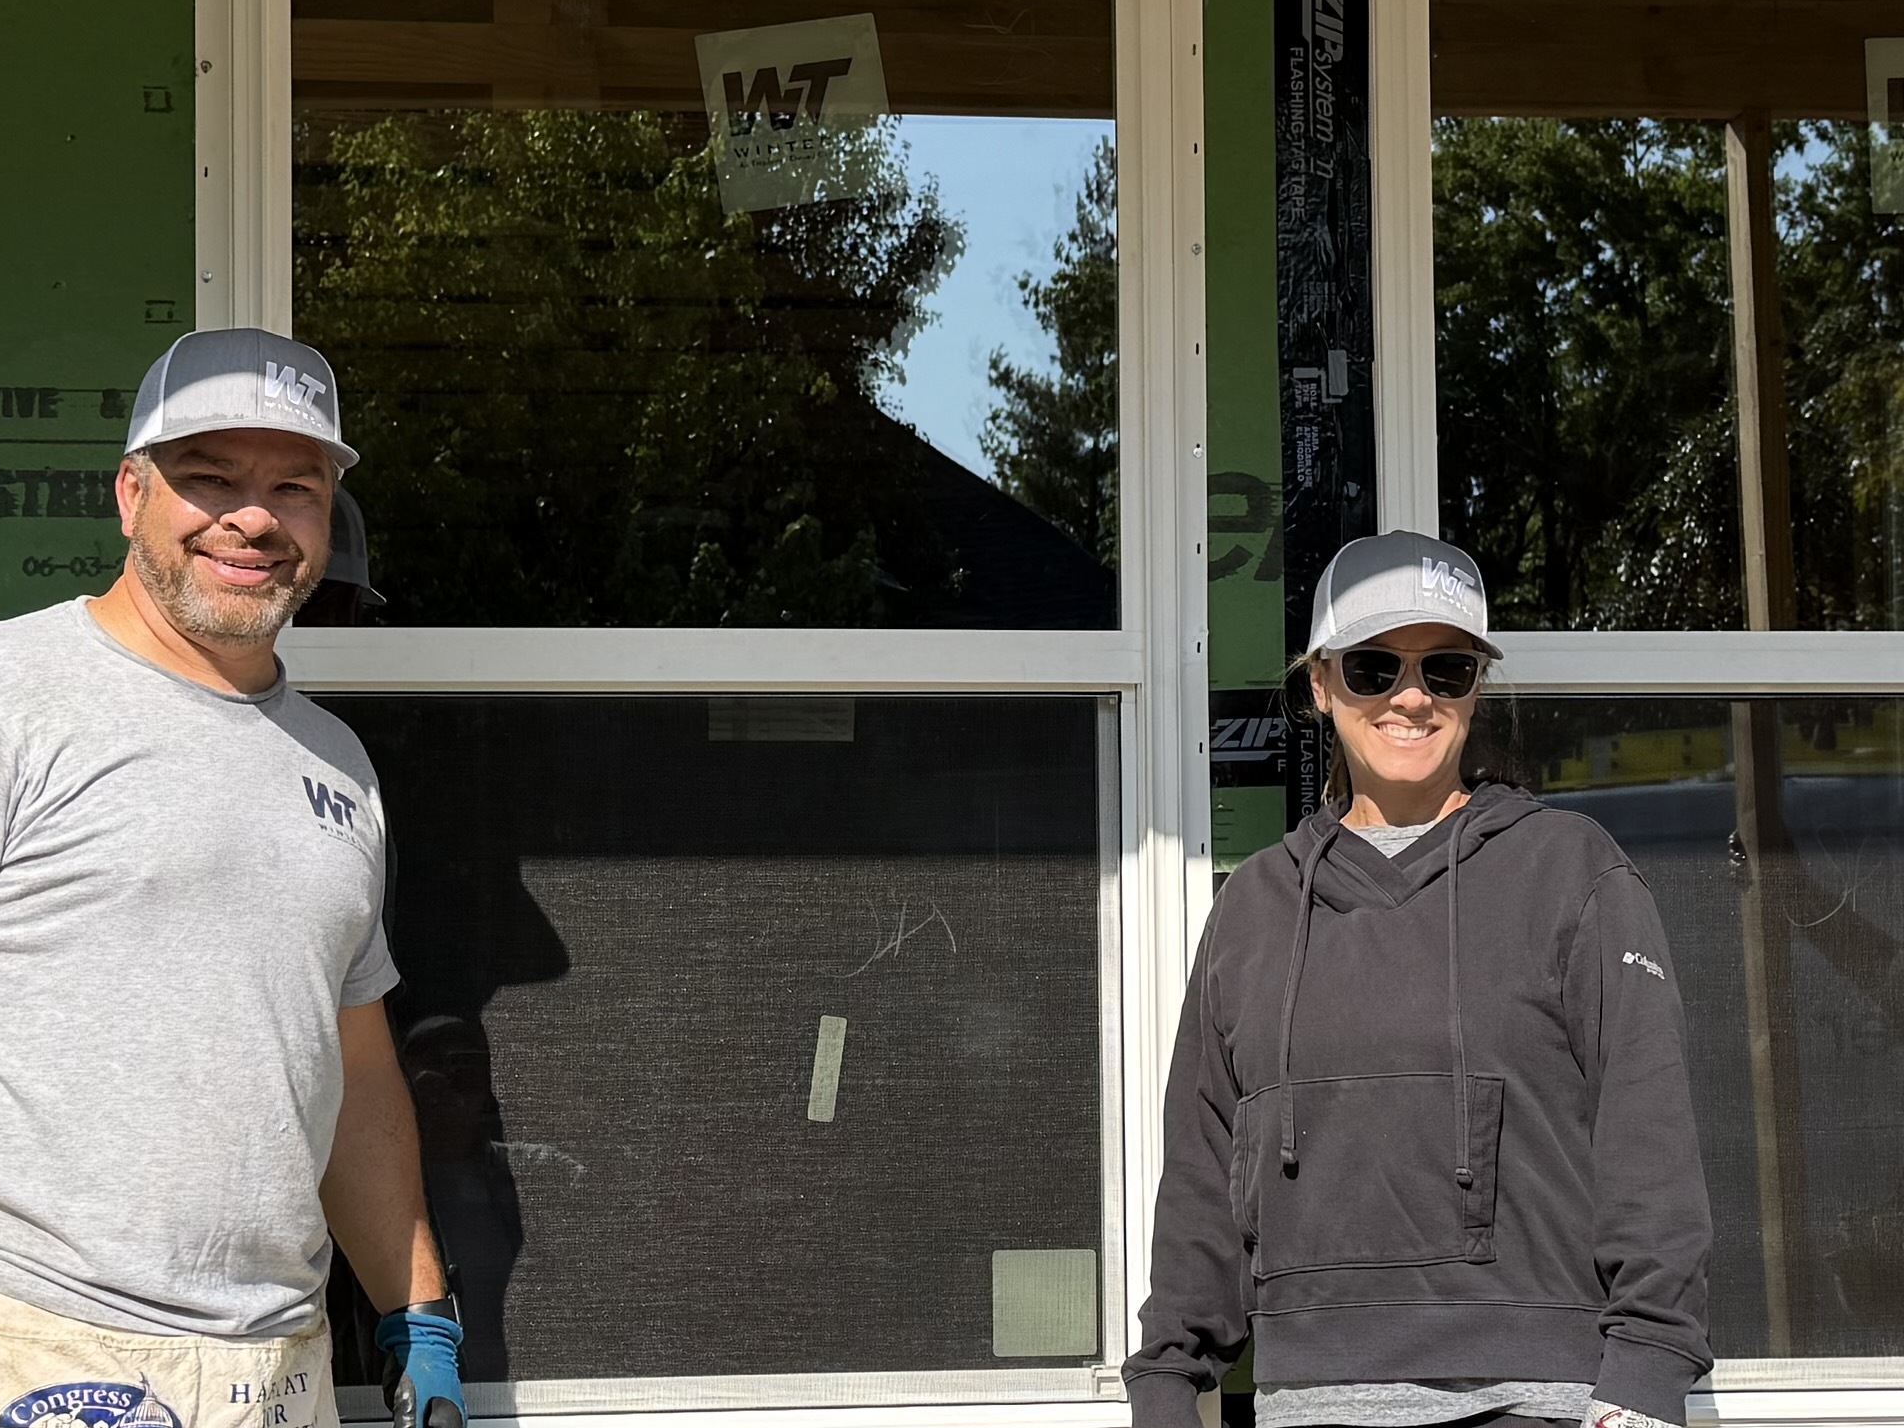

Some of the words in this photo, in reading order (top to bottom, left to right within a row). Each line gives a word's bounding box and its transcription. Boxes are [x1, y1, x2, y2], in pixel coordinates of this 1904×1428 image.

[721, 57, 853, 137] WT
[264, 360, 327, 410] WT
[1420, 556, 1476, 604] WT
[301, 775, 357, 832] WT
[10, 1384, 131, 1426] Congress
